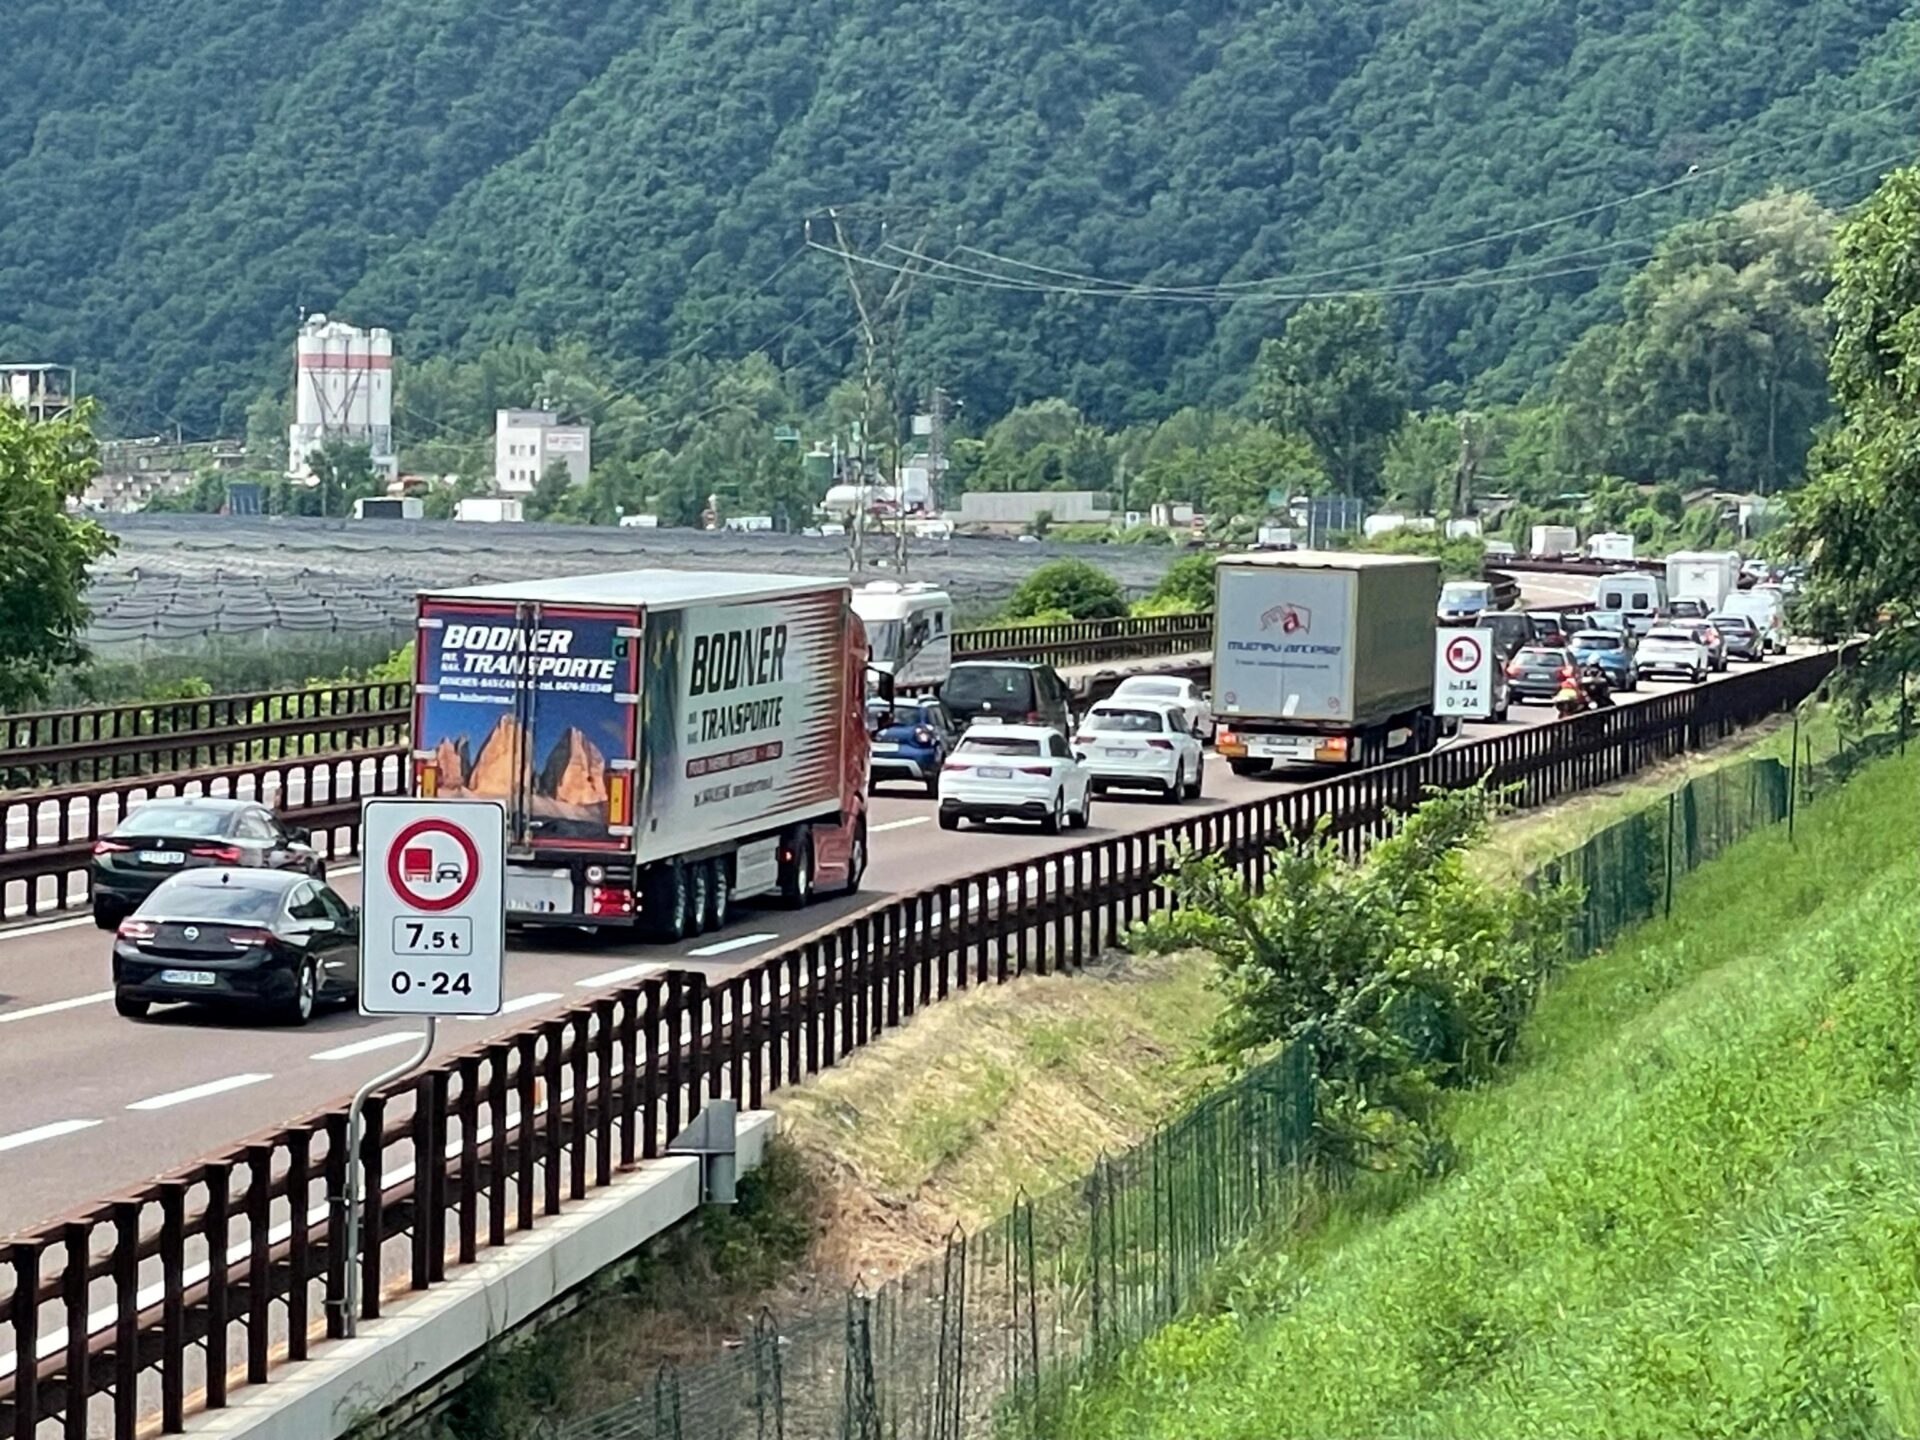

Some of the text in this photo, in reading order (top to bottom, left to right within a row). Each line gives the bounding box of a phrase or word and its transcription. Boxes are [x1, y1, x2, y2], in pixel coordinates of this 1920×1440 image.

[441, 624, 573, 653] BODNER
[463, 653, 617, 679] TRANSPORTE
[688, 624, 788, 697] BODNER
[700, 696, 784, 743] TRANSPORTE
